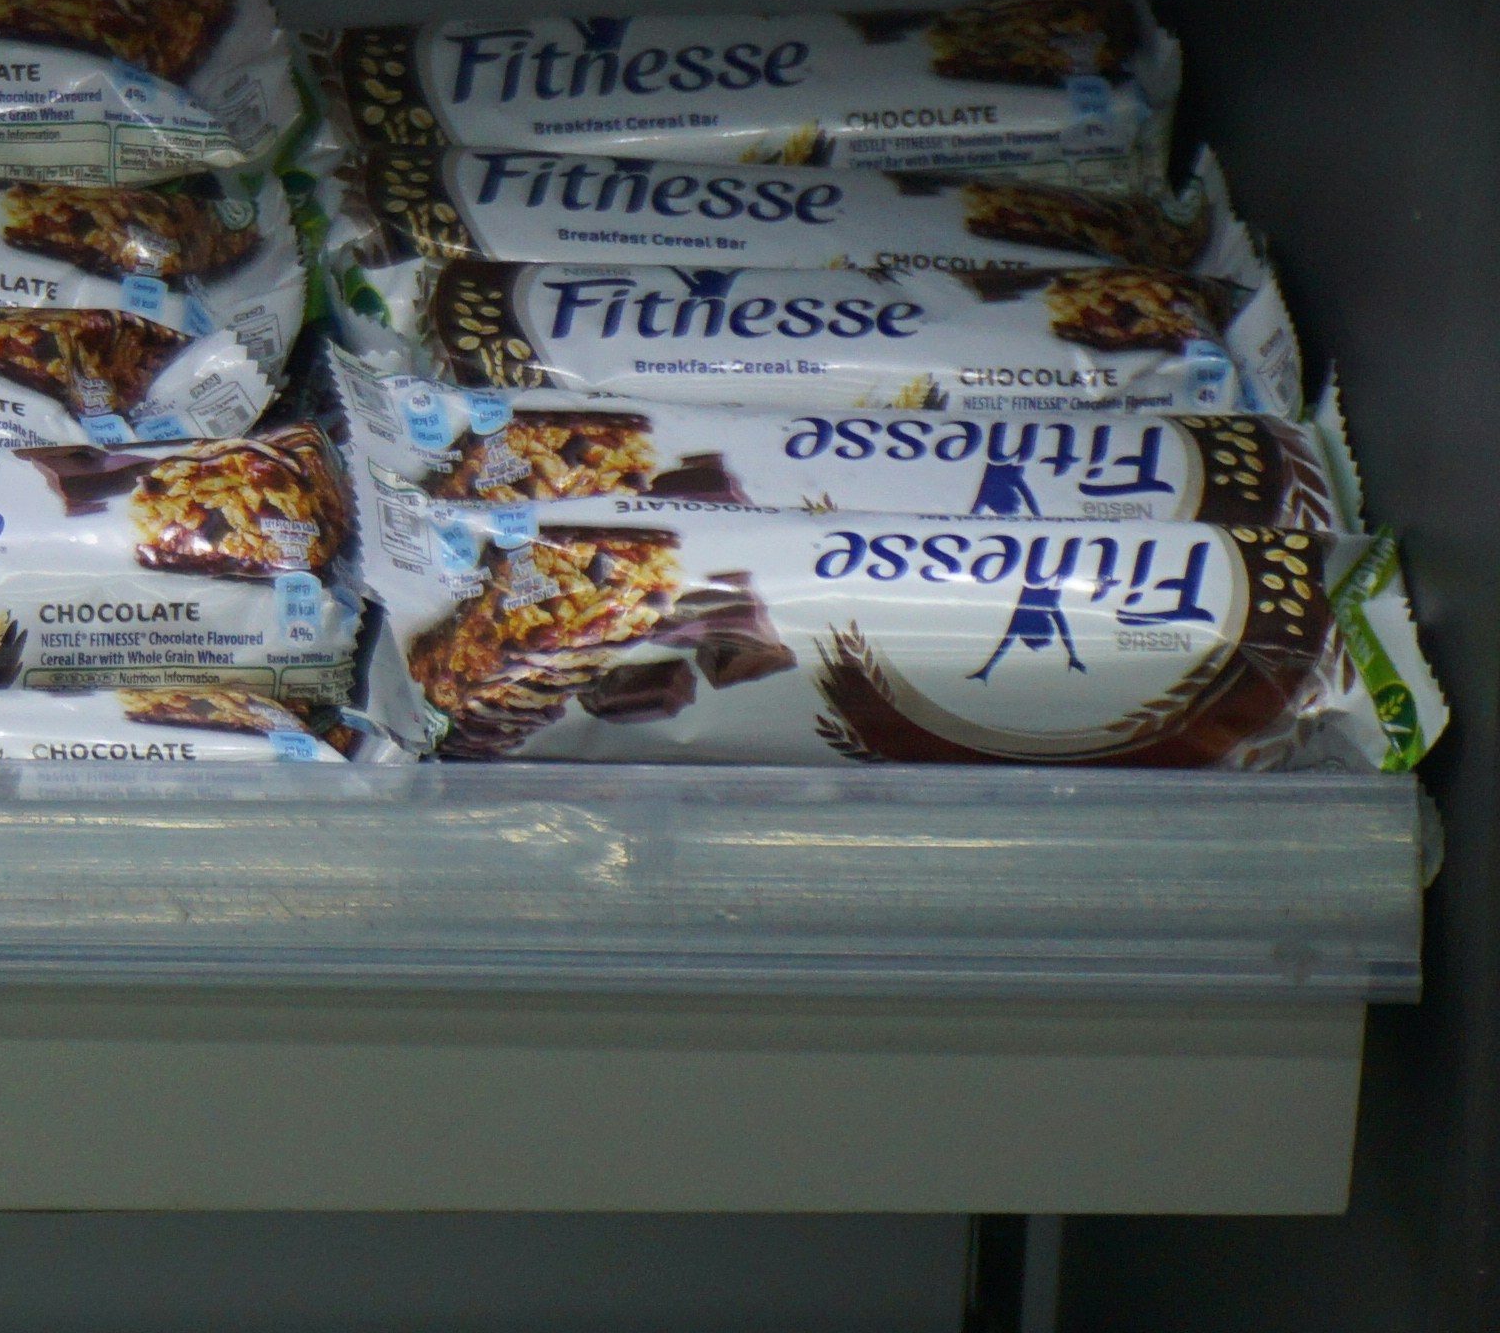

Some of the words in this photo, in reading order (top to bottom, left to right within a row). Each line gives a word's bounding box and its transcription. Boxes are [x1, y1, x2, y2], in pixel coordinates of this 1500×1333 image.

[446, 28, 812, 106] Fitnesse
[542, 276, 926, 343] Fitnesse
[958, 366, 1119, 389] CHOCOLATE
[816, 531, 1218, 626] Fitnesse
[38, 600, 200, 625] CHOCOLATE
